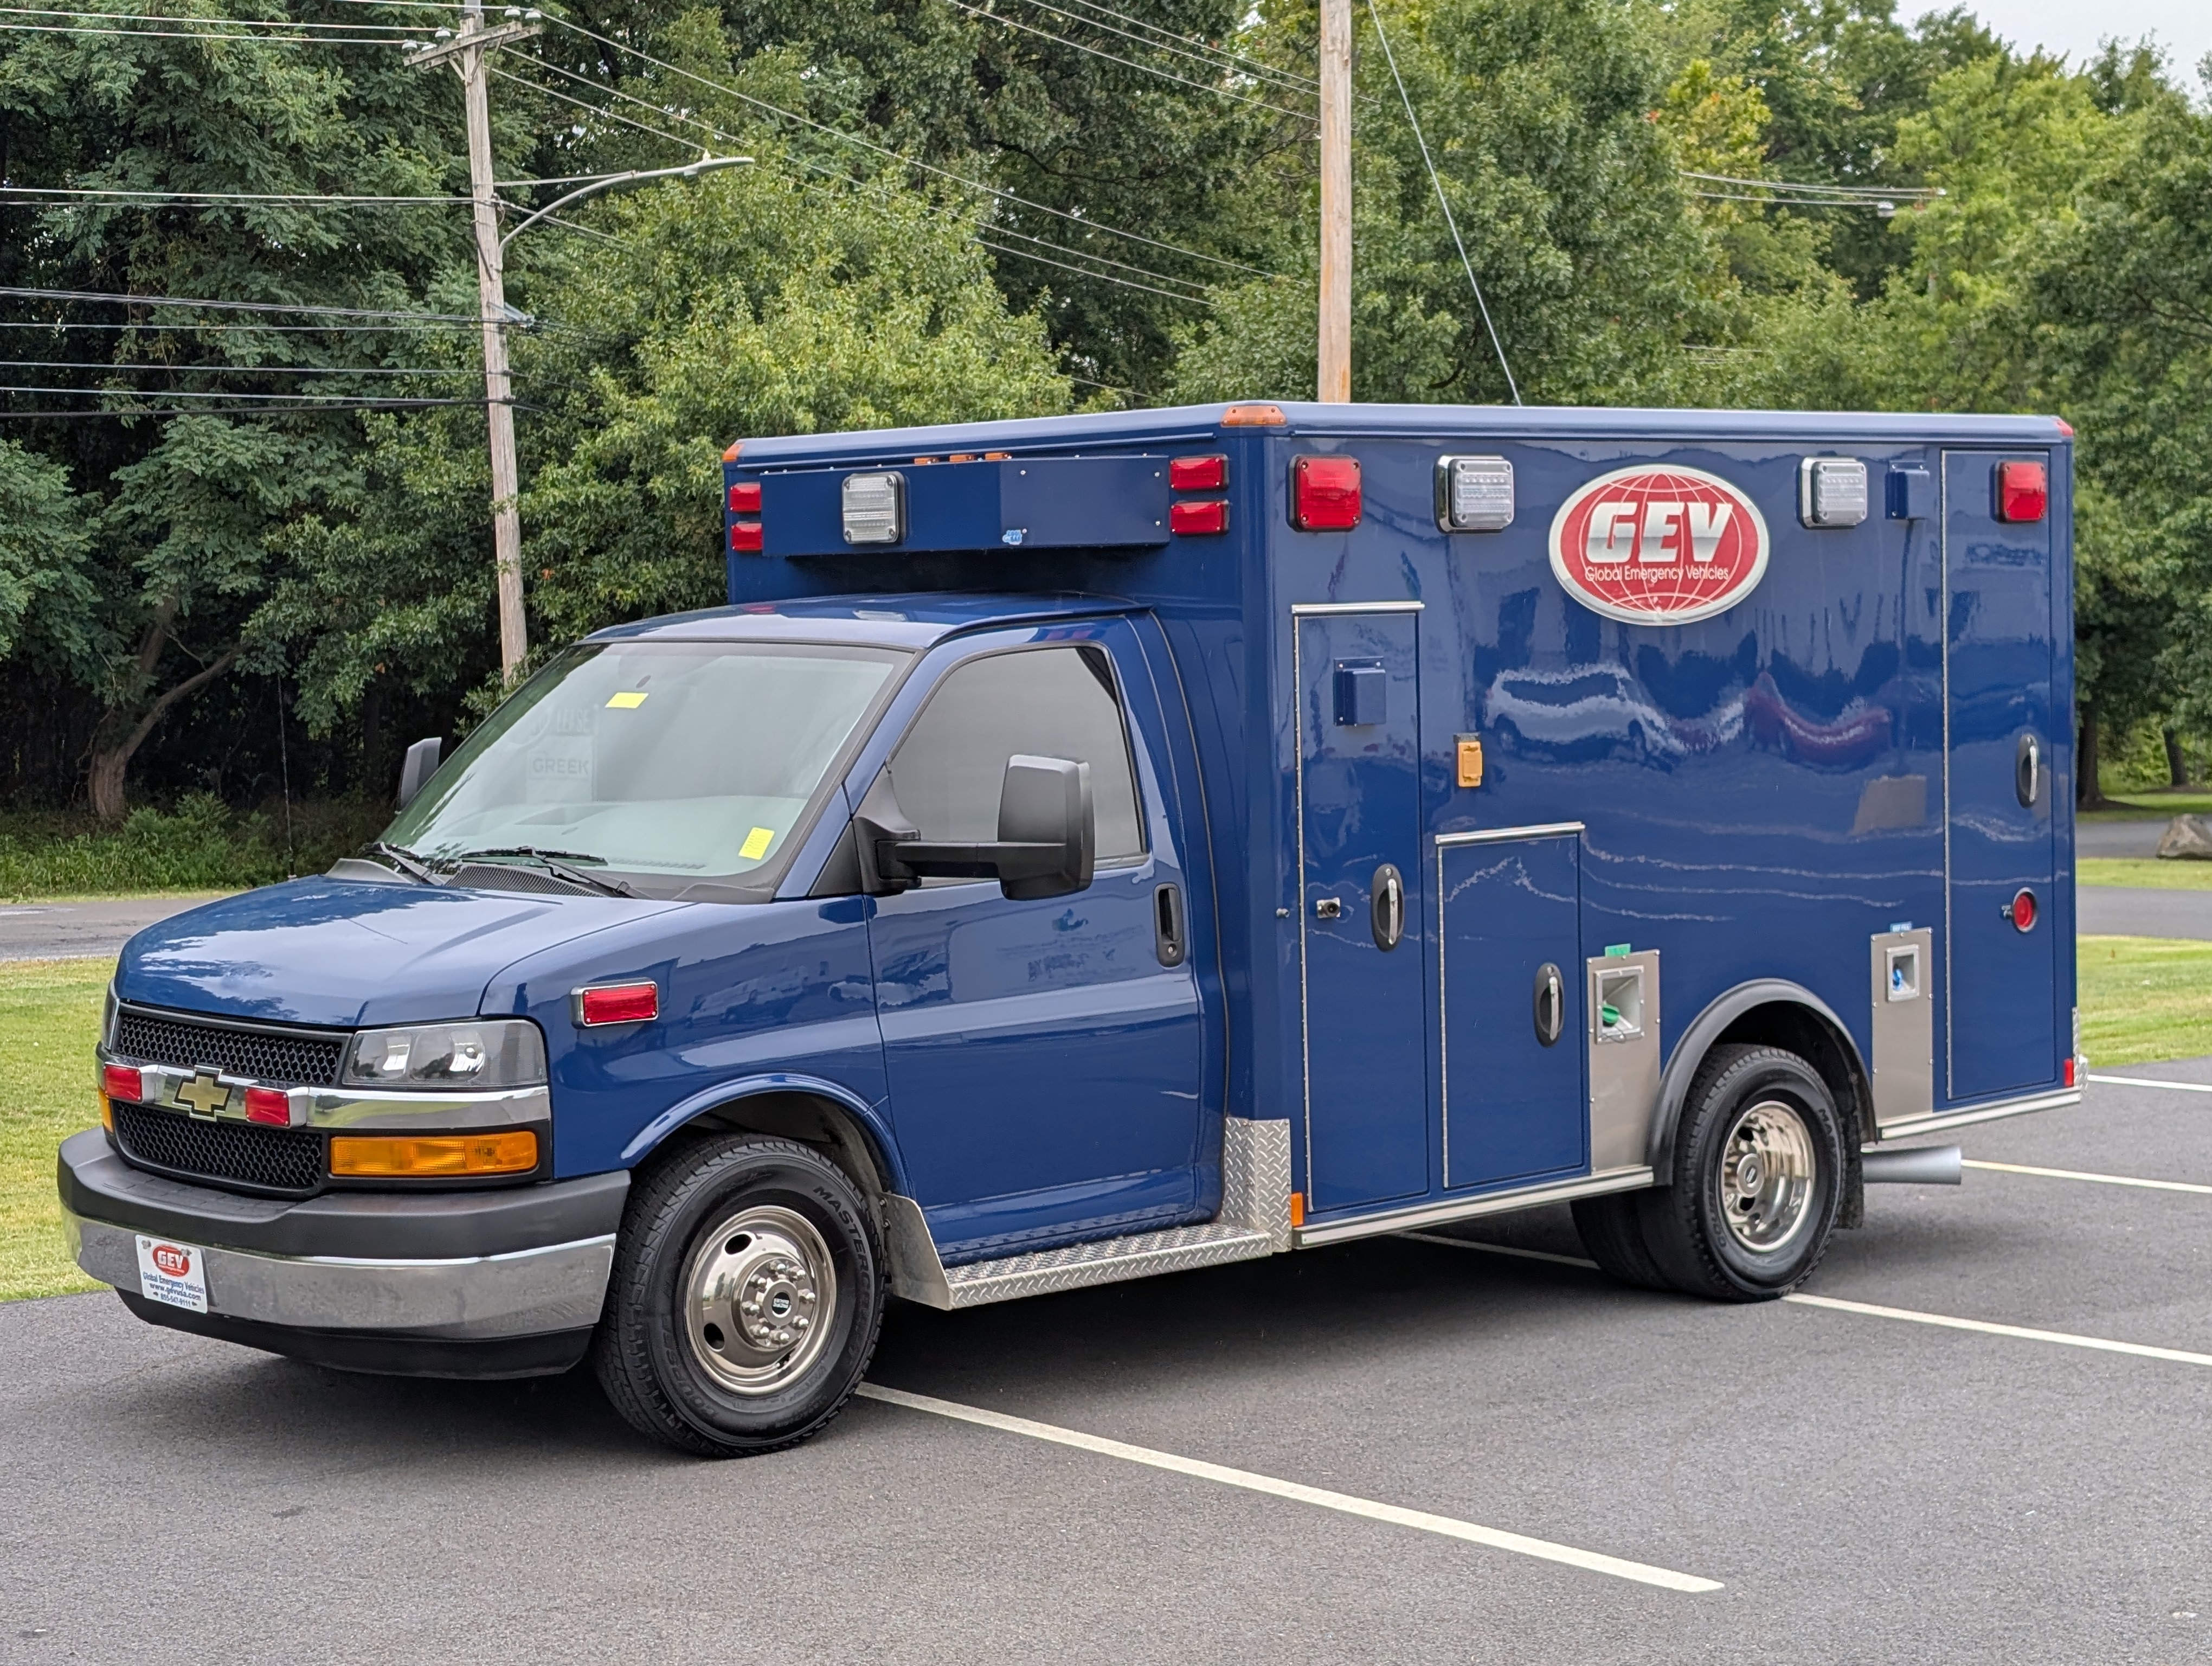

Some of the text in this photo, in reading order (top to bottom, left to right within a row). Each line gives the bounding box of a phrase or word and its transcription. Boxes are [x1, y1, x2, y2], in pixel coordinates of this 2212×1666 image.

[1585, 502, 1733, 563] GEV
[1586, 563, 1729, 585] Global Emergency Vehicles
[532, 758, 589, 776] GREEK
[157, 1250, 184, 1269] GEV
